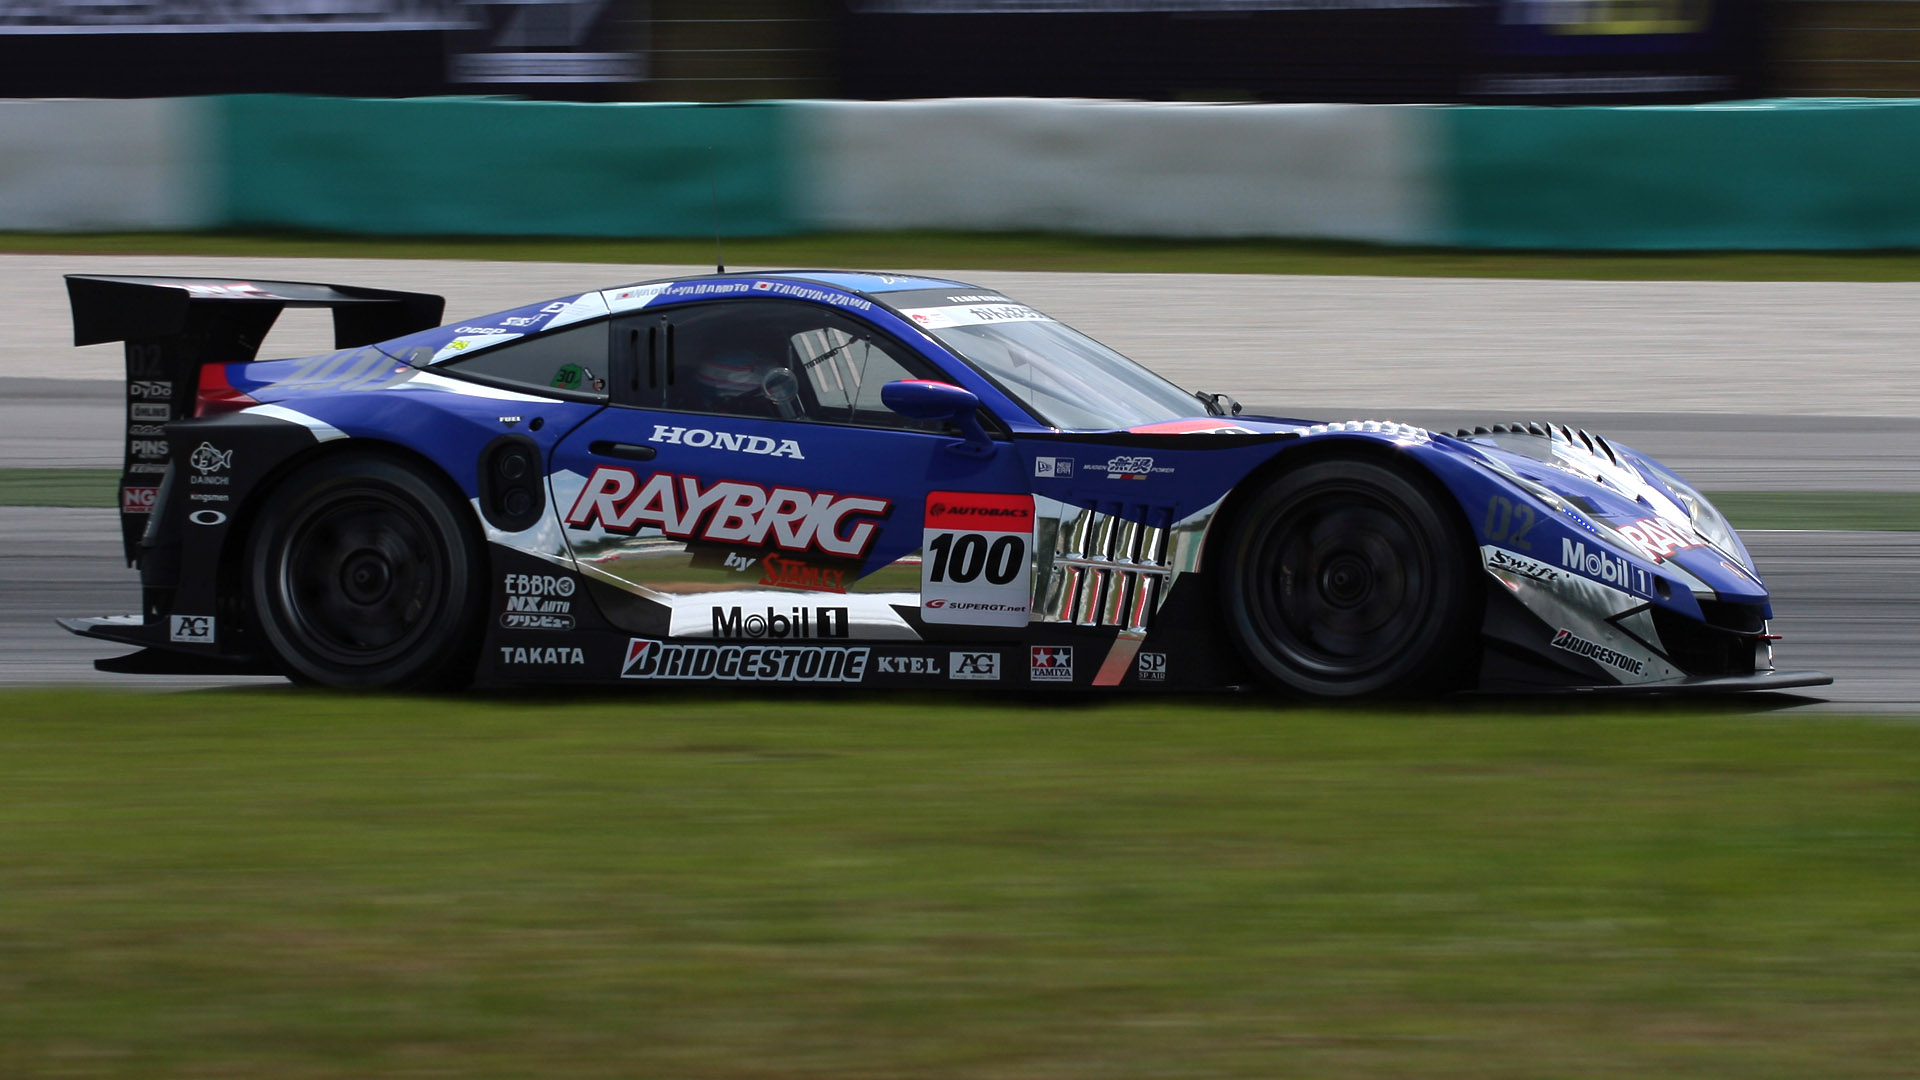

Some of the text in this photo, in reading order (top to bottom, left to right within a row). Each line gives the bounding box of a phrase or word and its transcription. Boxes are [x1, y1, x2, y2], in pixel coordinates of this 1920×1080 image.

[557, 369, 576, 383] 30
[130, 384, 172, 398] DyDo
[131, 440, 169, 454] PINS
[648, 424, 805, 460] HONDA
[124, 489, 159, 506] NG
[564, 464, 892, 558] RAYBRIG
[947, 506, 1029, 517] AUTOBACS
[929, 533, 1025, 585] 100
[1489, 550, 1558, 580] Swift
[1562, 537, 1629, 588] Mobil
[724, 551, 847, 594] by STANLEY
[504, 574, 575, 597] EBBRO
[506, 596, 570, 613] NX AUTO
[949, 602, 1026, 612] SUPERGT.net
[176, 617, 209, 637] AG
[506, 615, 570, 627] クリンビュー
[712, 606, 809, 638] Mobil
[501, 647, 584, 664] TAKATA
[621, 638, 870, 682] BRIDGESTONE
[1551, 628, 1643, 675] BRIDGESTONE
[877, 657, 940, 674] KTEL
[956, 654, 995, 674] AG
[1140, 654, 1165, 671] SP
[1032, 667, 1071, 677] TAMIYA
